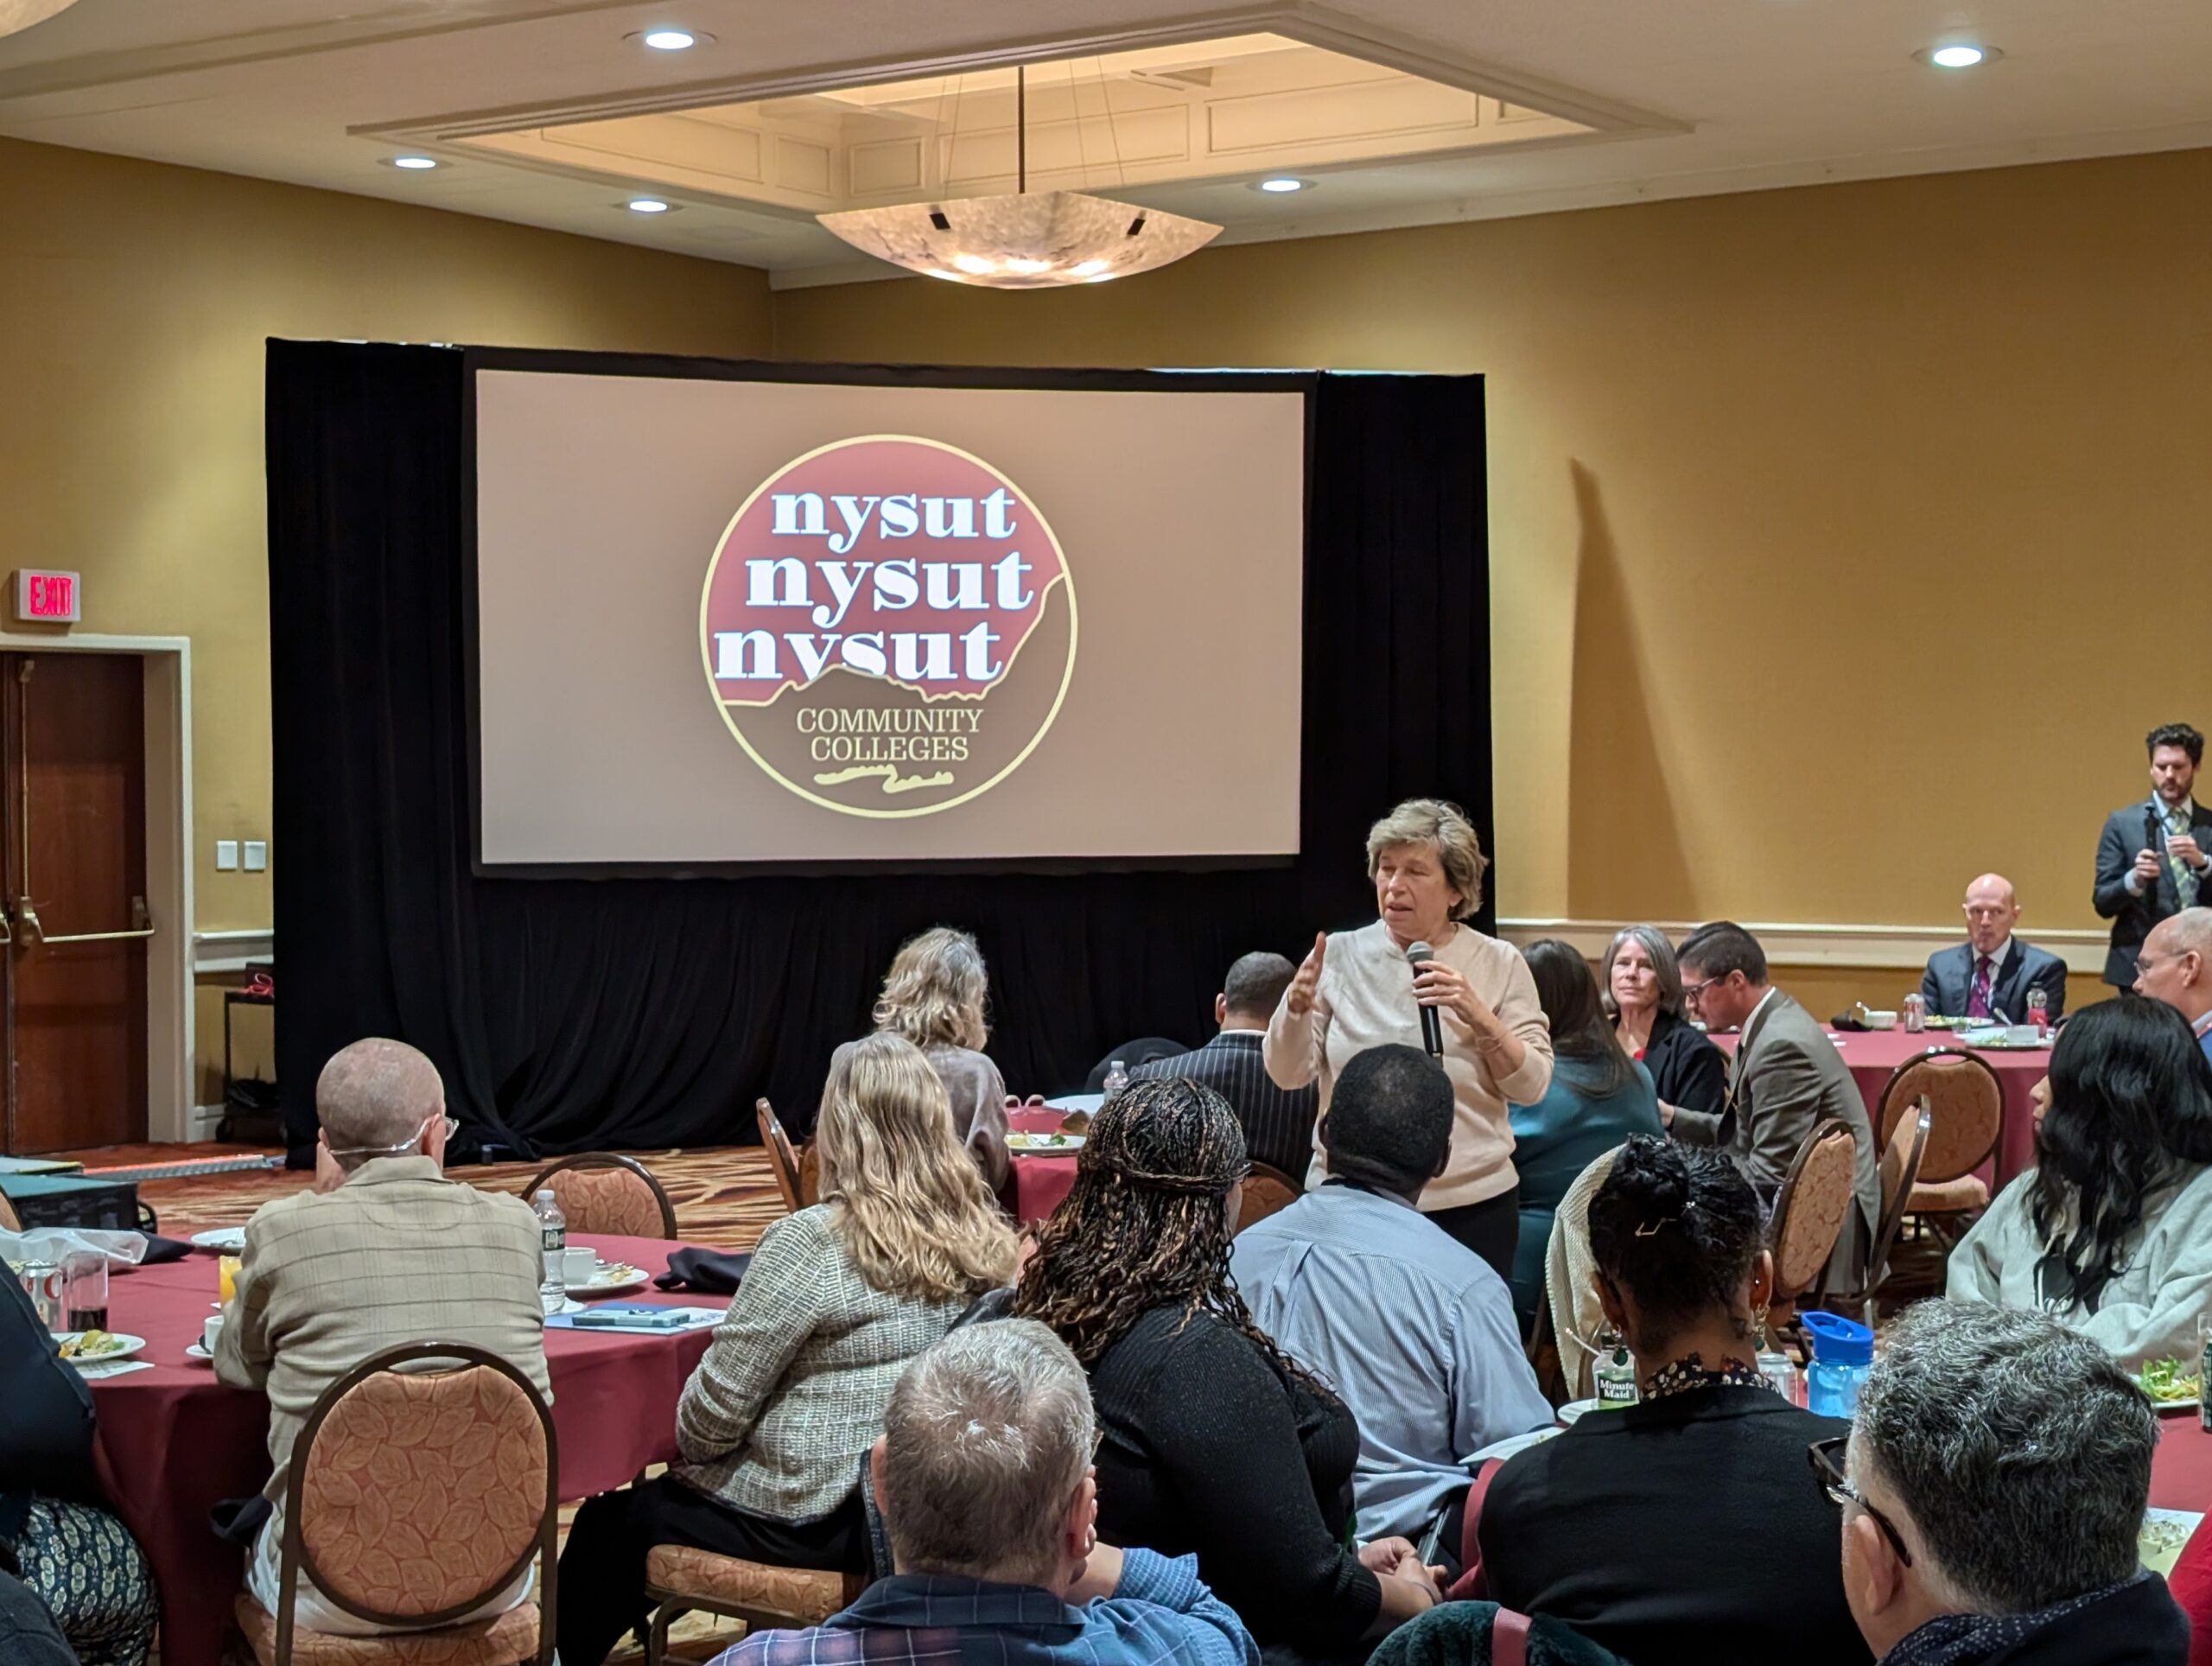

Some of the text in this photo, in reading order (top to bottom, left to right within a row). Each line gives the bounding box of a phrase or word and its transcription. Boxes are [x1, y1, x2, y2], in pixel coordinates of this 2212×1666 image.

[771, 487, 1017, 554] nysut
[30, 575, 72, 615] EXIT
[745, 550, 1034, 629] nysut
[796, 708, 984, 734] COMMUNITY
[810, 736, 969, 762] COLLEGES
[1600, 1379, 1635, 1390] Minute
[1604, 1389, 1630, 1399] Maid
